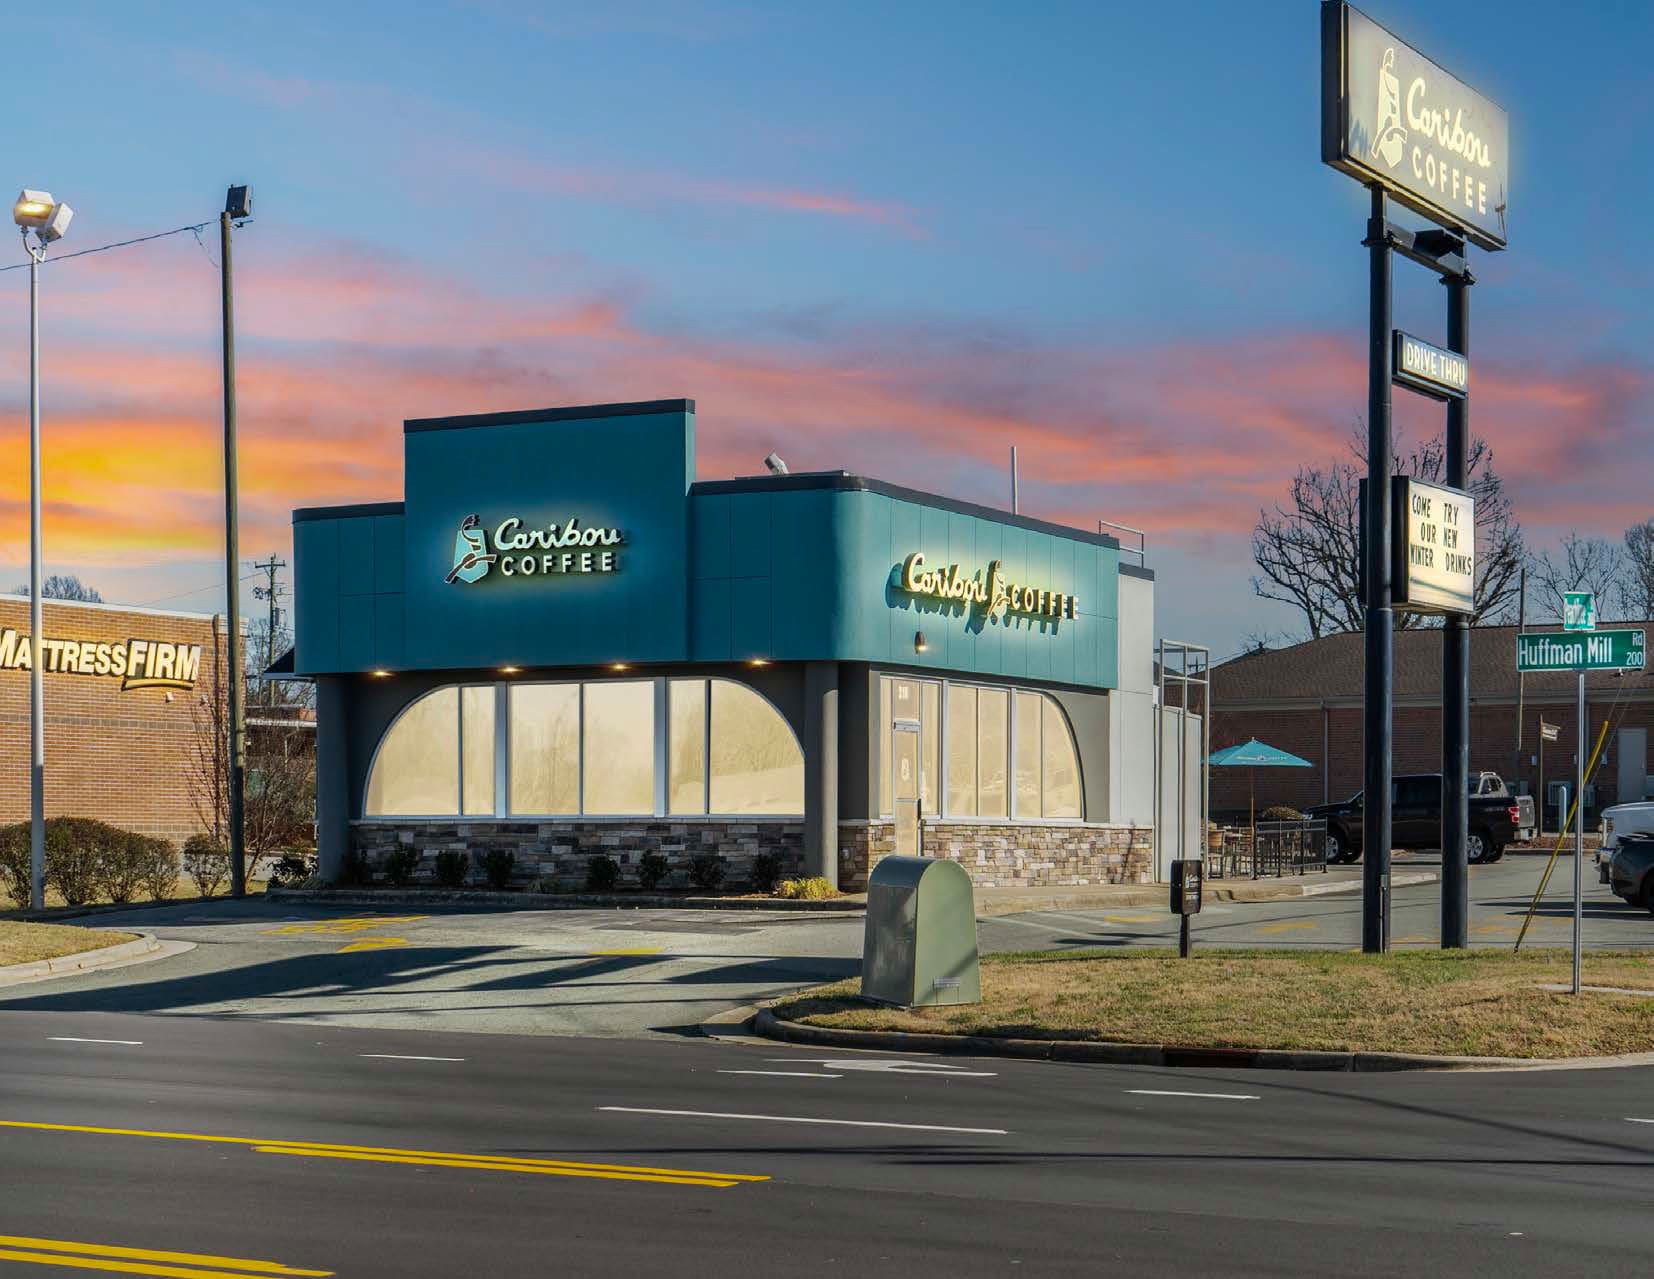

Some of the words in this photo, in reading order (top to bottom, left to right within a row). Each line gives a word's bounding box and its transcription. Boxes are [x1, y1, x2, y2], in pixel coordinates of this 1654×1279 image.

[1407, 77, 1491, 168] Caribou
[1412, 145, 1486, 215] COFFEE
[1407, 342, 1437, 375] DRIVE
[1440, 355, 1465, 386] THRU
[1412, 494, 1432, 519] COME
[1443, 502, 1459, 526] TRY
[494, 517, 622, 551] Caribou
[1420, 522, 1436, 544] OUR
[1443, 527, 1458, 549] NEW
[501, 551, 613, 576] COFFEE
[1410, 543, 1434, 568] WINTER
[1446, 551, 1472, 576] DRINKS
[903, 552, 988, 602] Caribou
[1519, 638, 1583, 665] Huffman
[1587, 636, 1613, 663] Mill
[1632, 632, 1643, 646] Rd
[1626, 651, 1643, 666] 200
